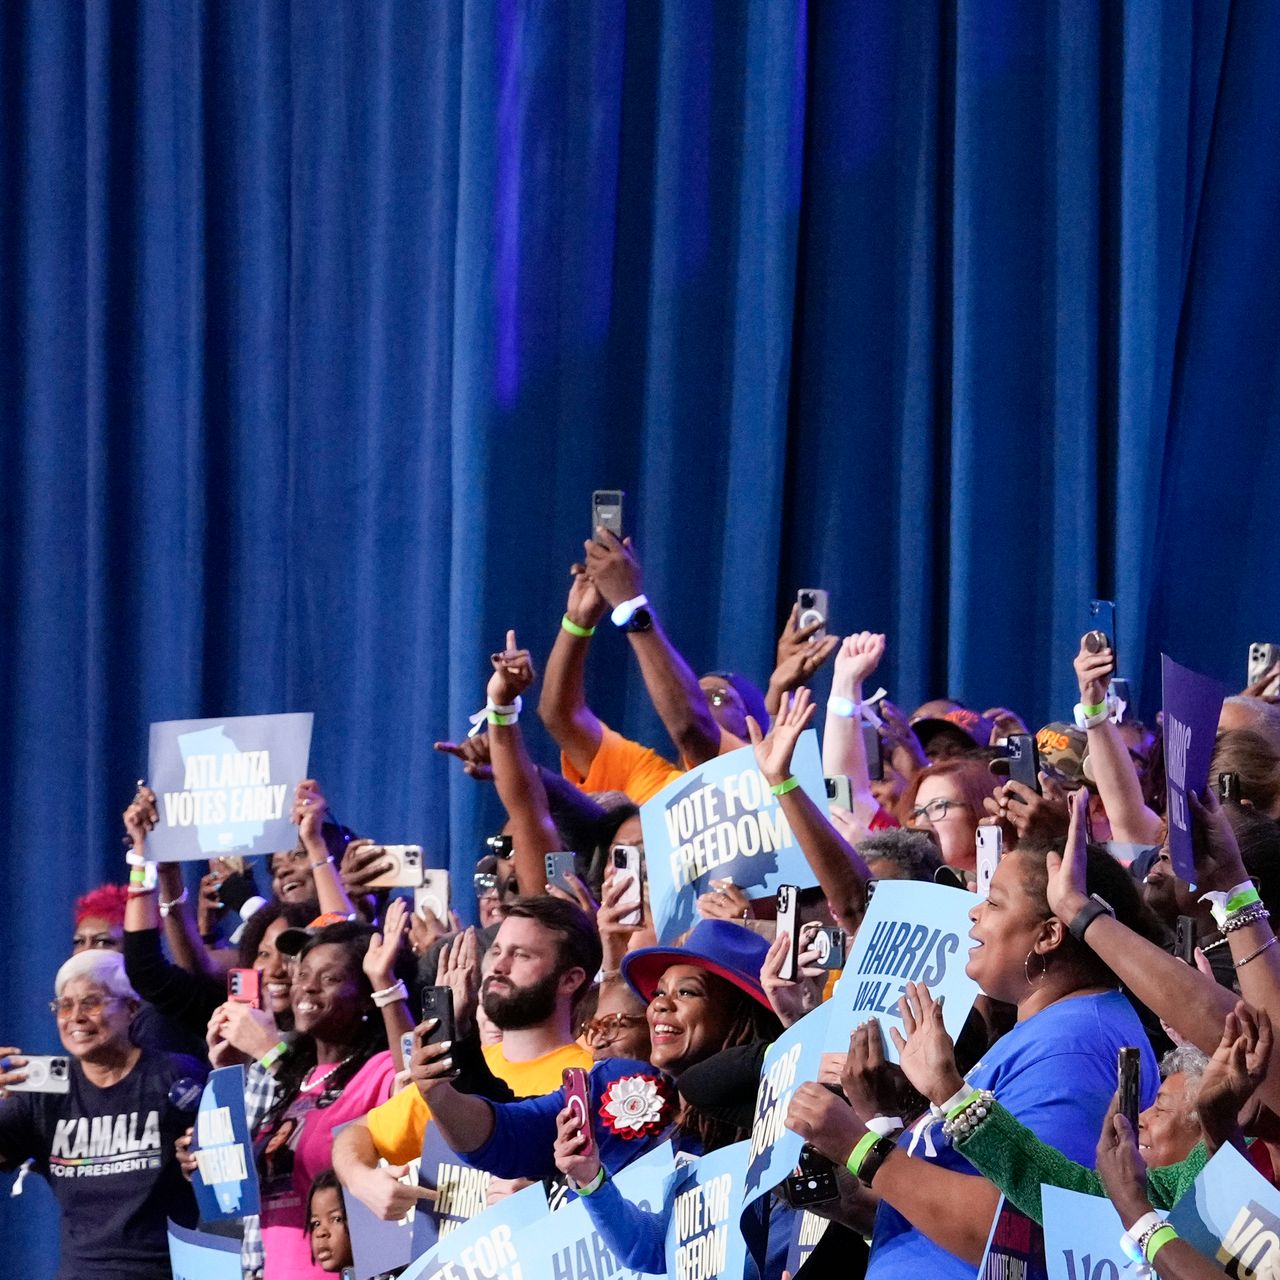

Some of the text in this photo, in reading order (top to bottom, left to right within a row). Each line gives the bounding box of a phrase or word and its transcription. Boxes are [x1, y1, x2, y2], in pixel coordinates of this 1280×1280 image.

[183, 750, 271, 790] ATLANTA
[163, 783, 288, 827] VOTES EARLY
[664, 783, 720, 849] VOTE
[670, 807, 793, 893] FREEDOM
[857, 921, 960, 988] HARRIS
[51, 1110, 161, 1159] KAMALA
[49, 1157, 149, 1178] FOR PRESIDENT
[433, 1162, 490, 1218] HARRIS
[674, 1172, 732, 1246] VOTE FOR
